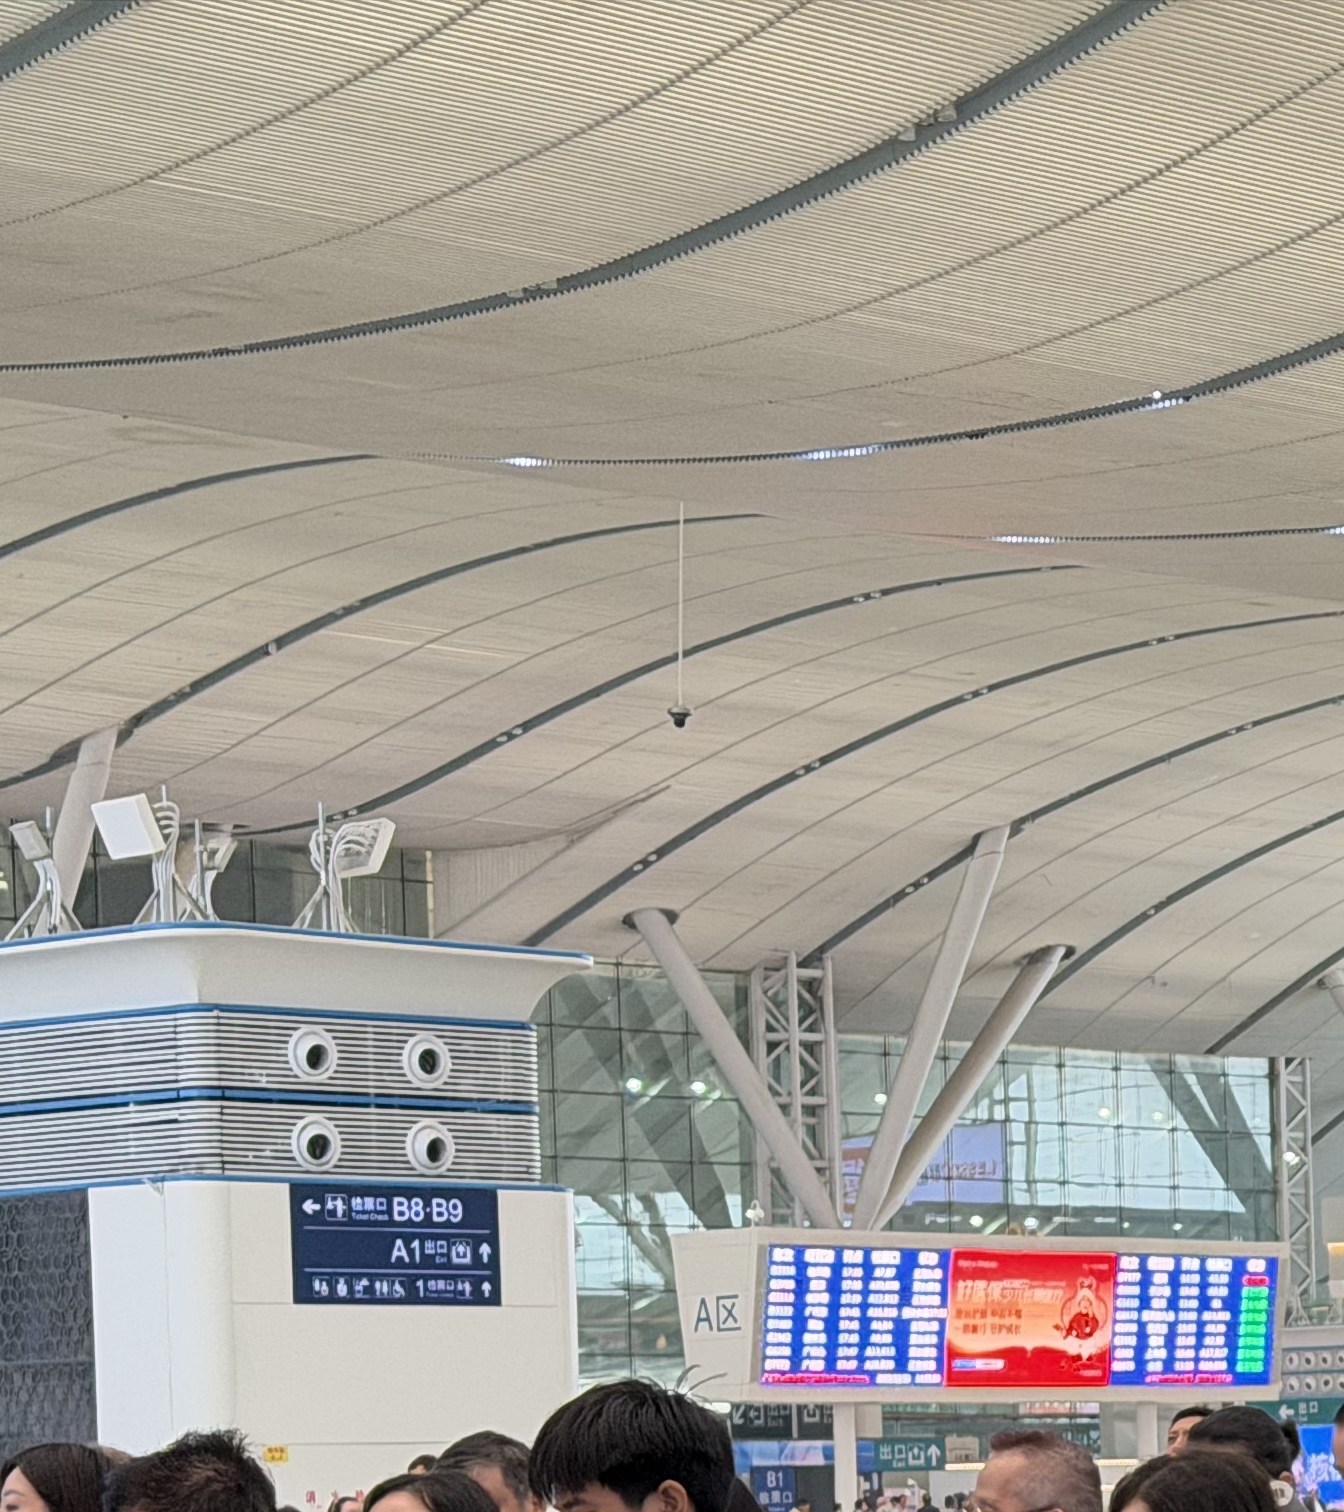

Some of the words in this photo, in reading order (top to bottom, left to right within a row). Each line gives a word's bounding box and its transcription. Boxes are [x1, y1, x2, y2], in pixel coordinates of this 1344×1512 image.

[351, 1196, 387, 1211] 检票口
[393, 1196, 463, 1223] B8·B9
[391, 1239, 420, 1264] A1
[424, 1240, 447, 1254] 出口
[694, 1294, 742, 1333] A区
[880, 1444, 906, 1460] 出口
[767, 1471, 784, 1488] B1
